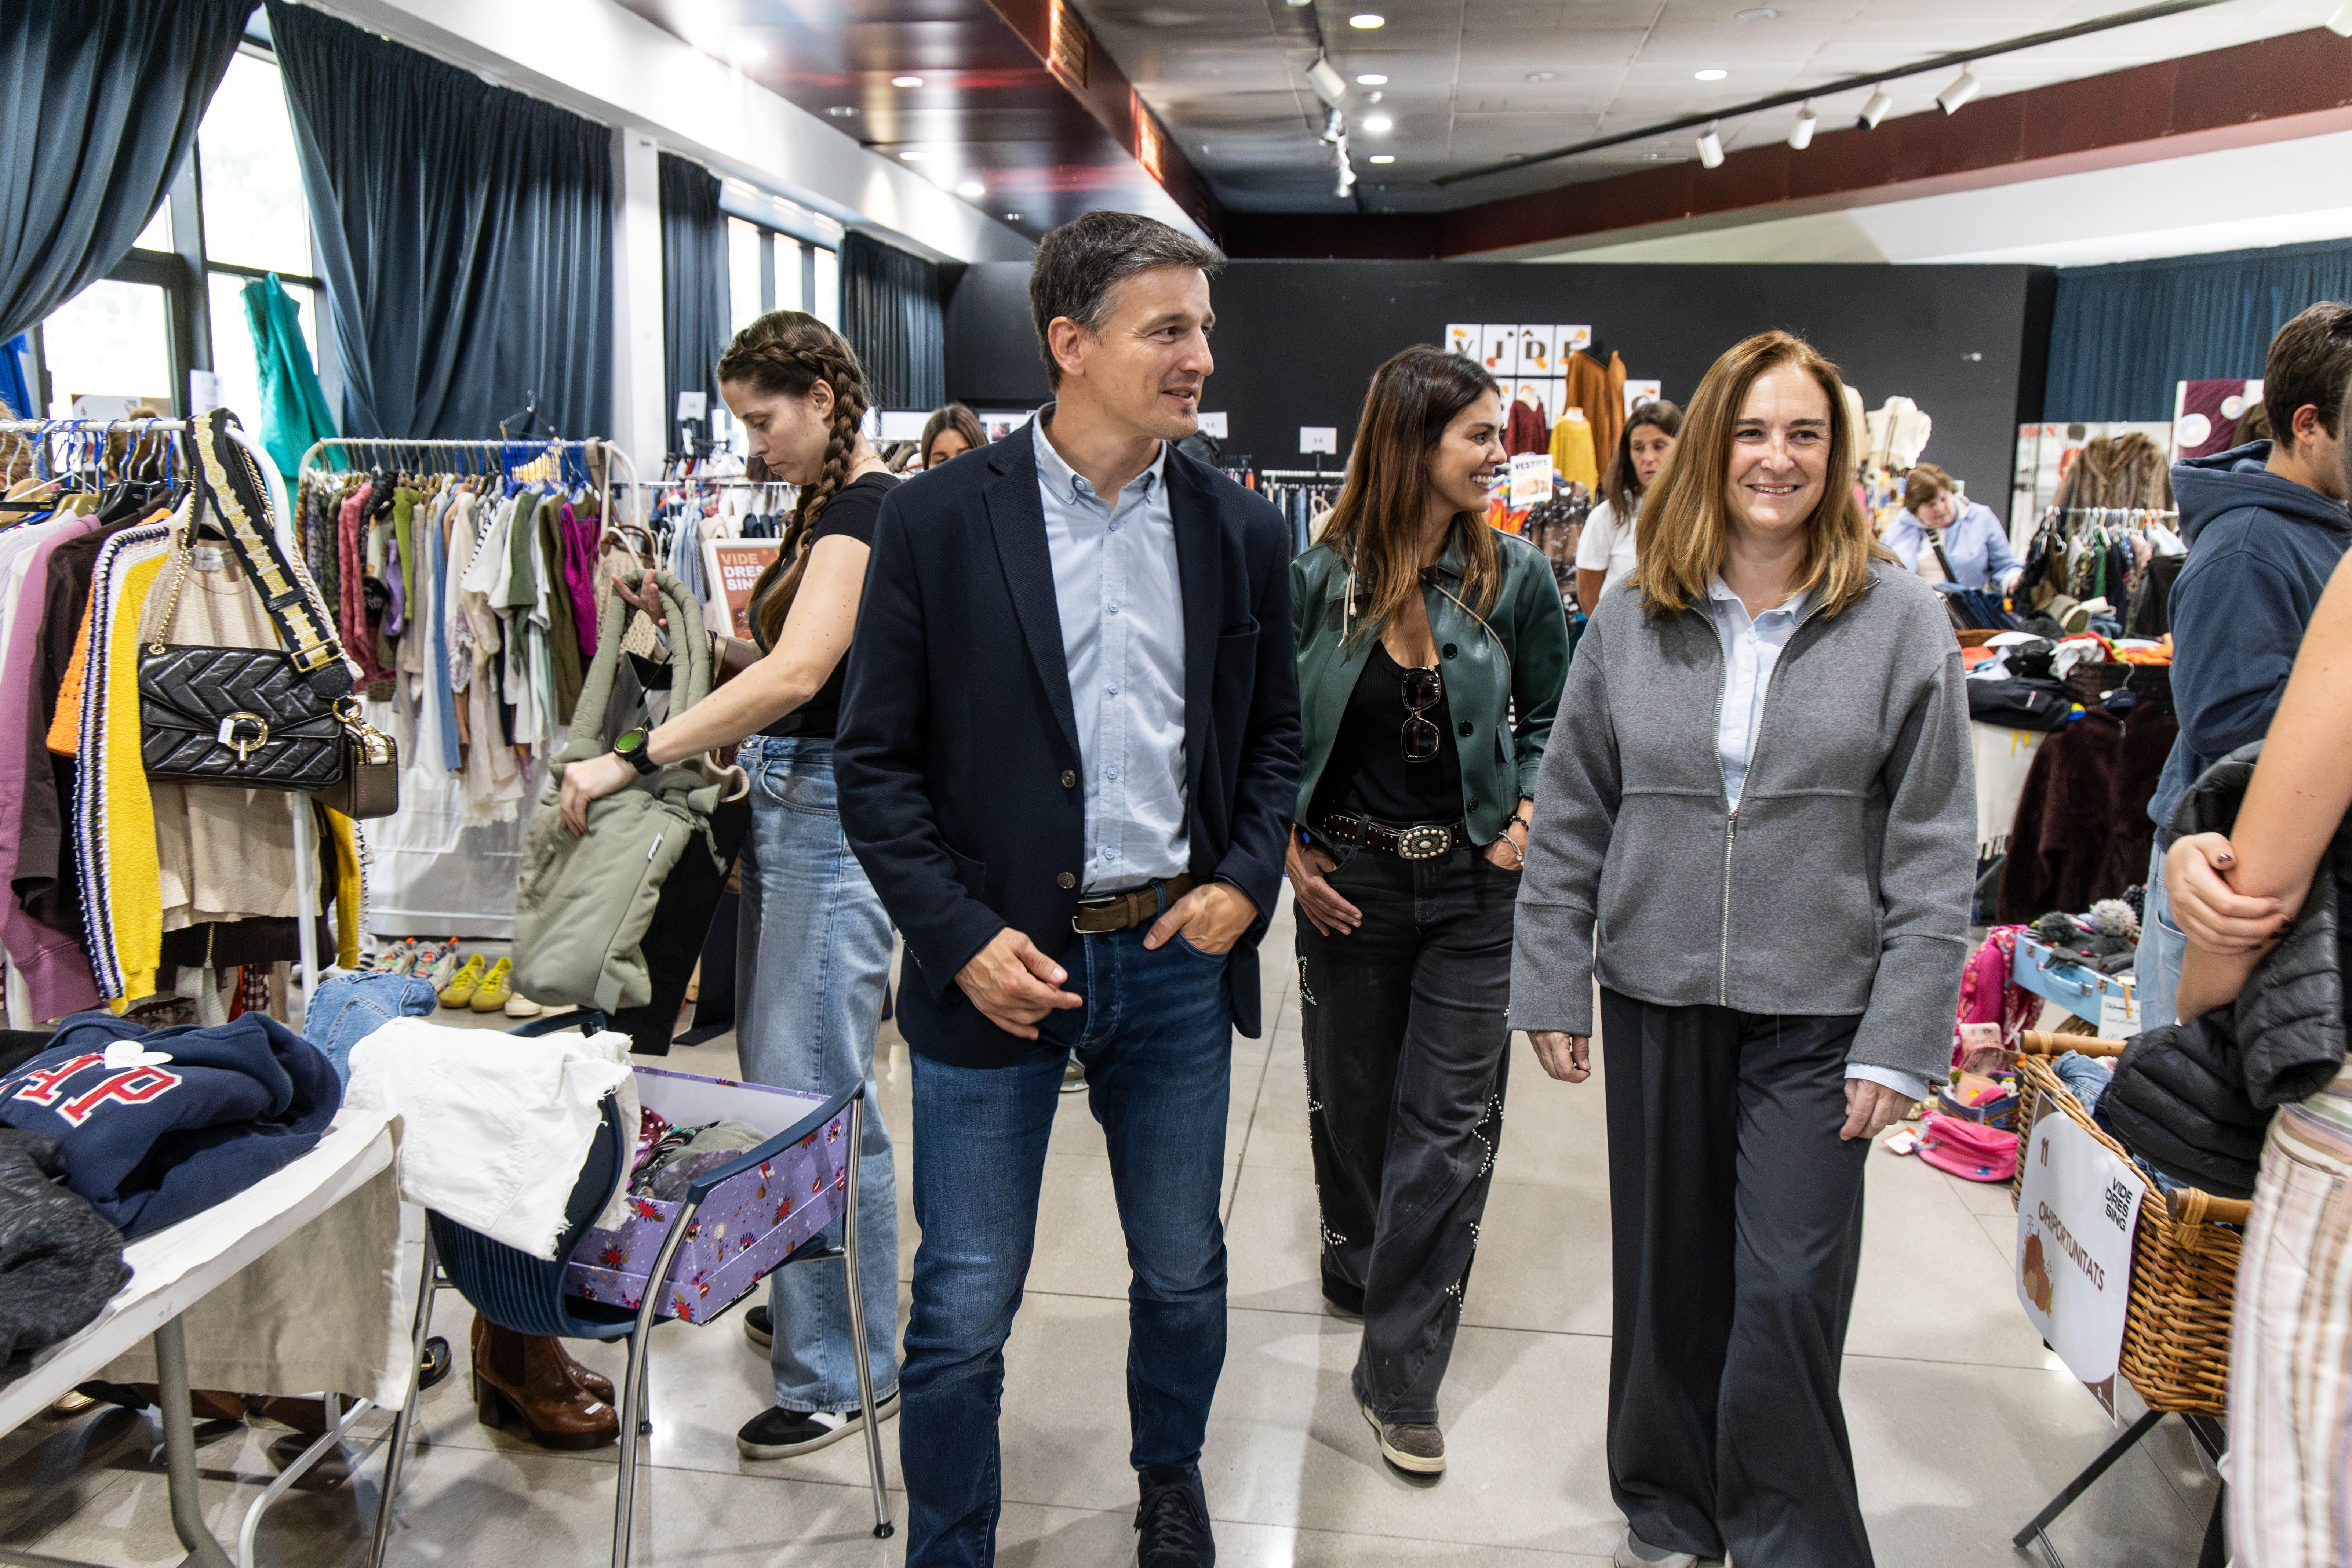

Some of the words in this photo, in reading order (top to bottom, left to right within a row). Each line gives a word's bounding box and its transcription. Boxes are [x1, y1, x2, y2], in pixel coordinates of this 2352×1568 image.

[204, 461, 280, 576] MARC
[720, 553, 759, 565] VIDE
[726, 579, 755, 591] SIN
[2105, 1187, 2129, 1218] DRES
[2112, 1176, 2133, 1205] VIDE
[2105, 1203, 2126, 1233] SING
